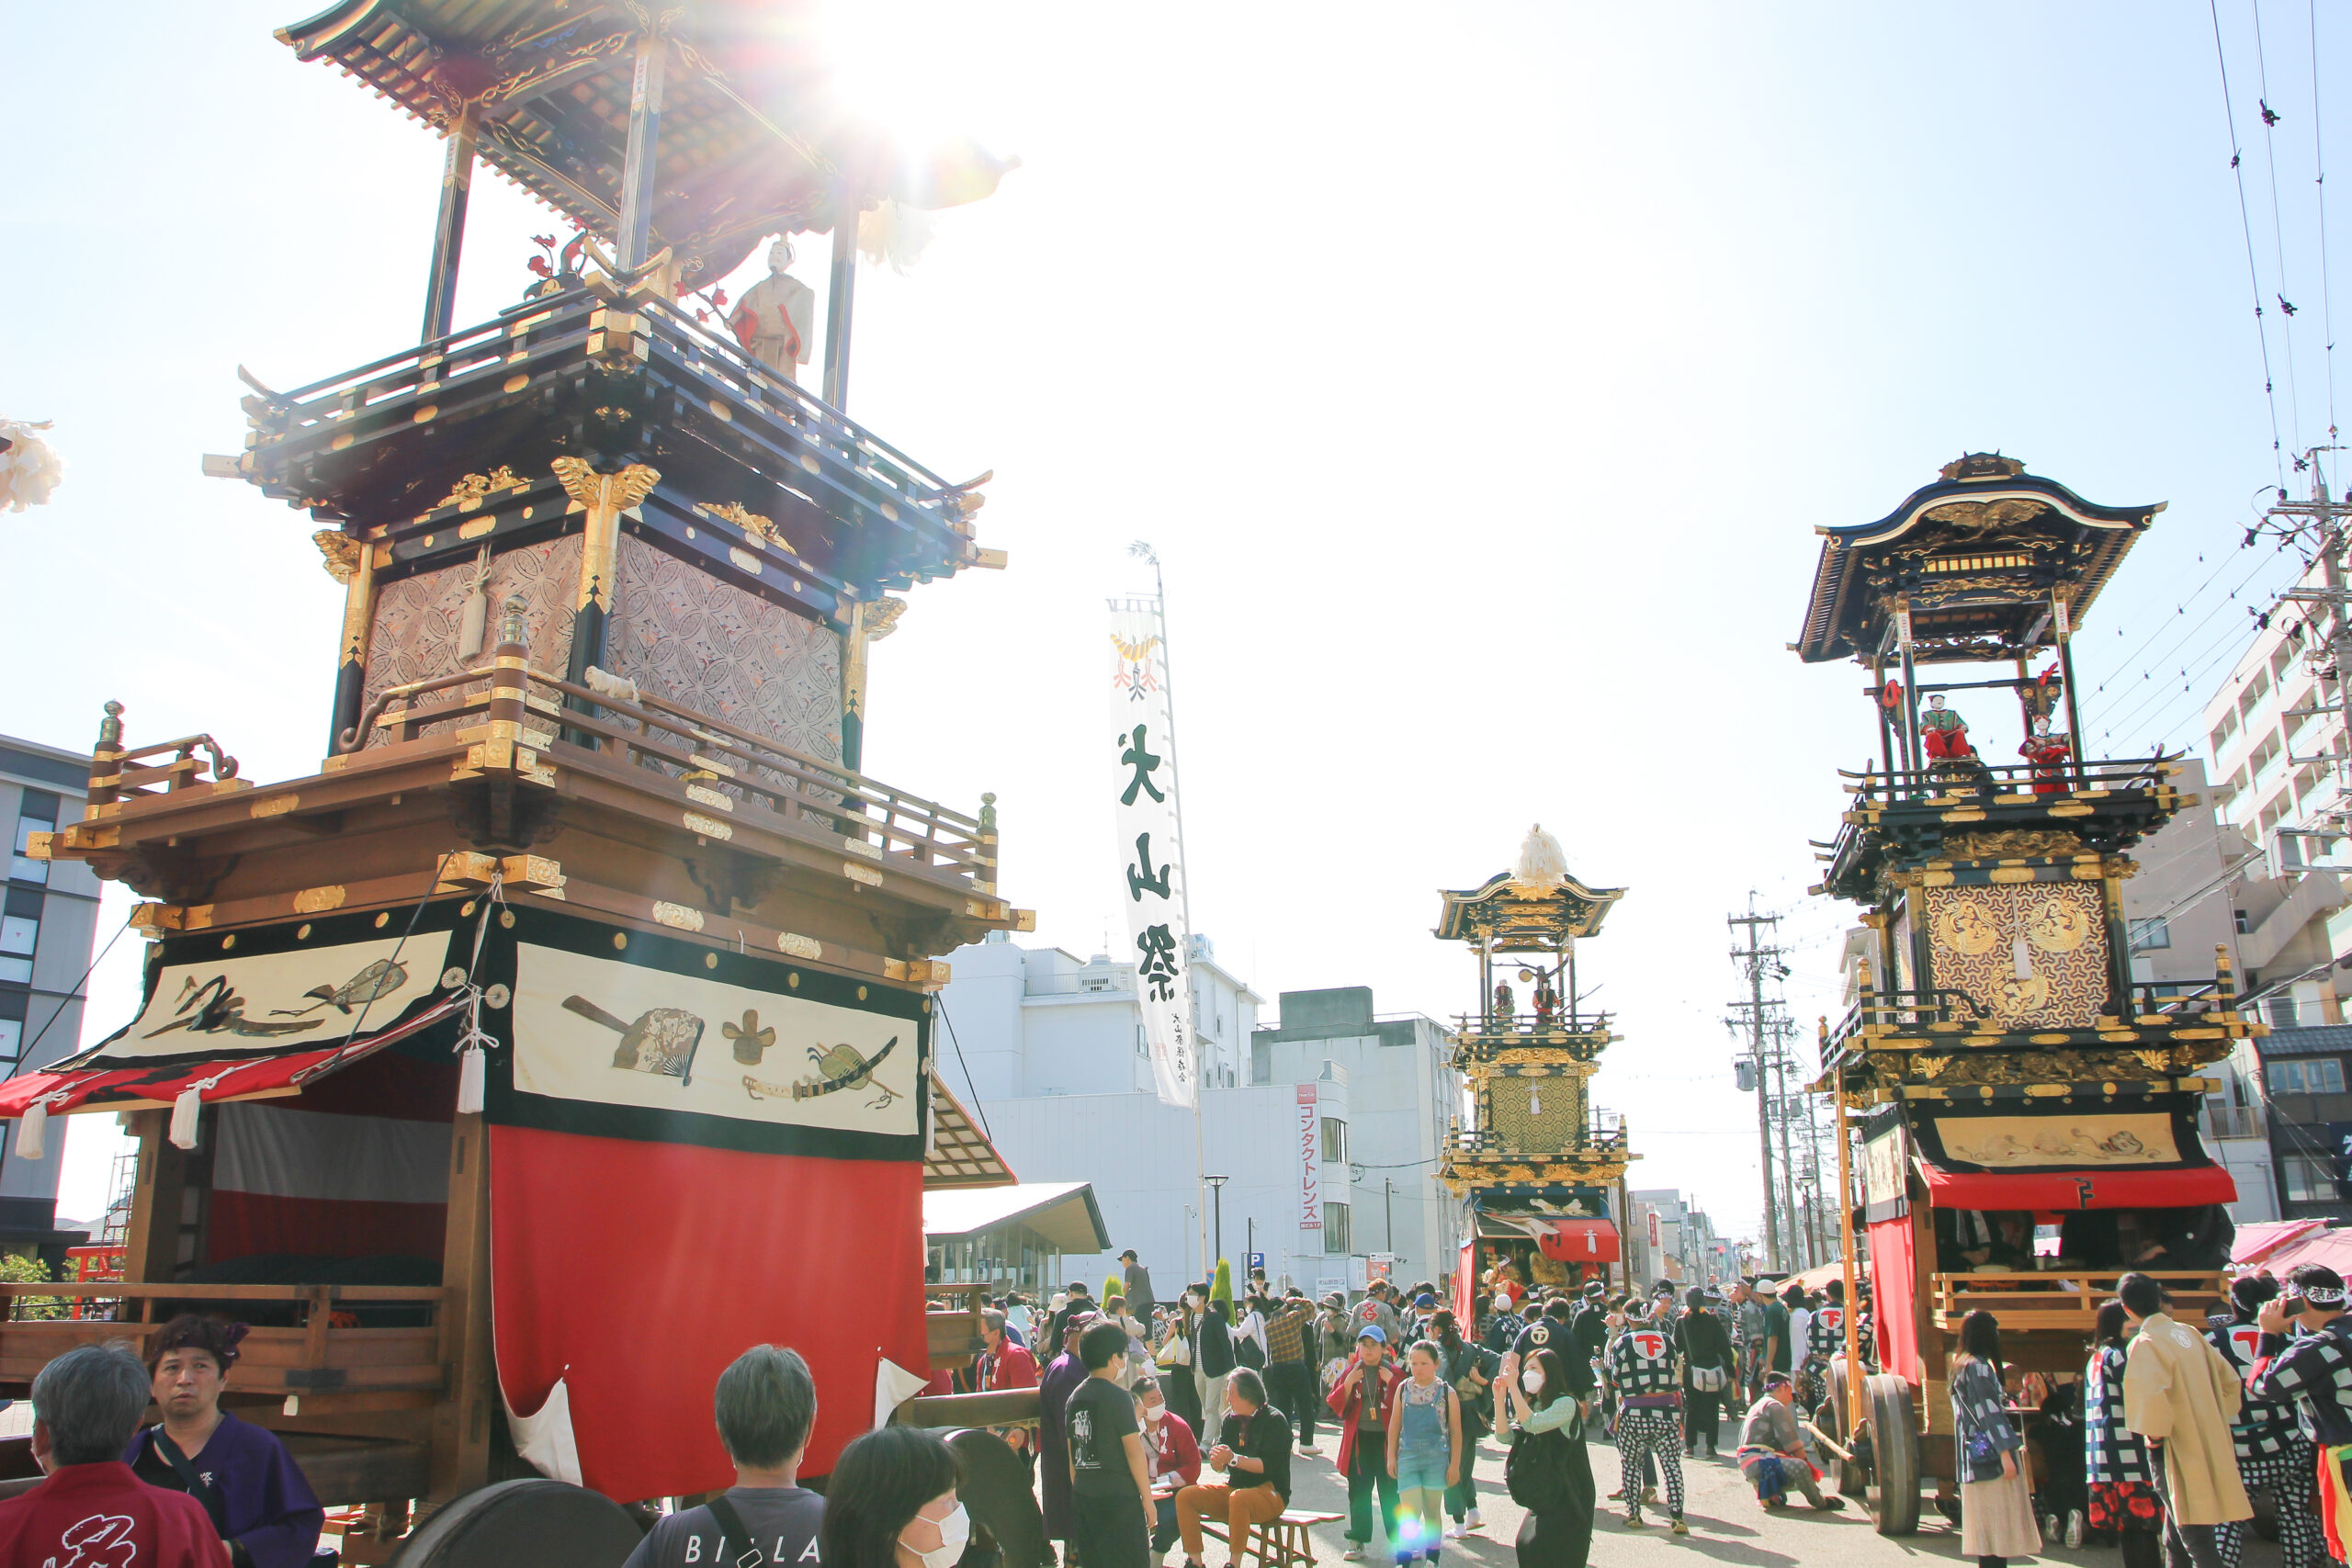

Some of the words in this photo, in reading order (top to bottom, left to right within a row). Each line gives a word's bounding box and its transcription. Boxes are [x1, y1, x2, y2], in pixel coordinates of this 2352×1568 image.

[1300, 1106, 1318, 1220] コンタクトレンズ
[1251, 1254, 1261, 1266] P
[685, 1535, 820, 1562] BILA
